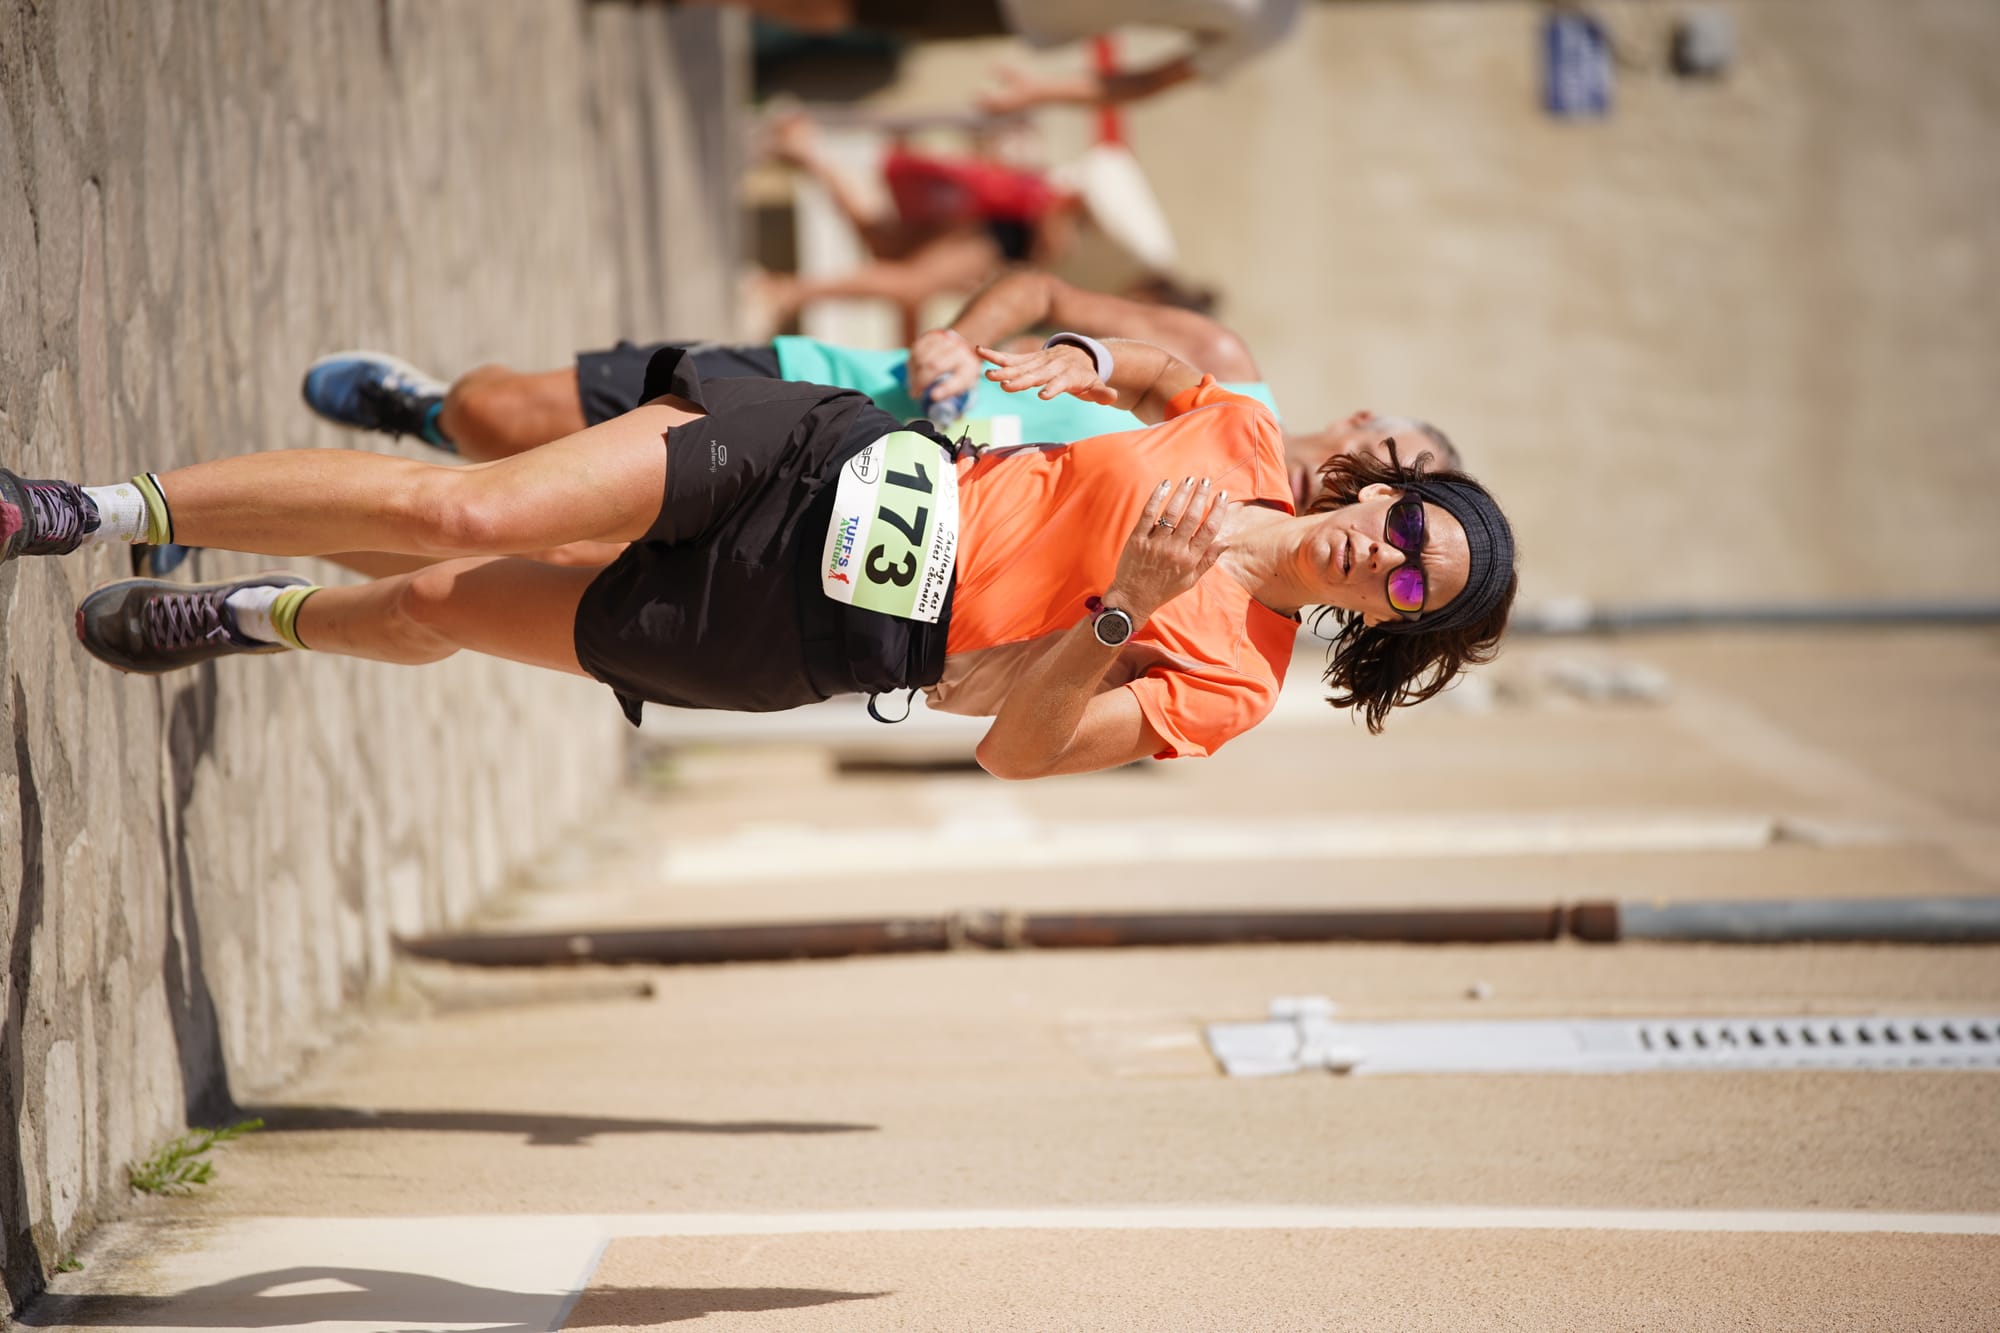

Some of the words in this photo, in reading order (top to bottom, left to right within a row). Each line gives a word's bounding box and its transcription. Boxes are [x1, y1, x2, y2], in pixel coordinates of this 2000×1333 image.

[709, 440, 717, 473] Kalenji
[830, 518, 850, 570] Aventure
[838, 516, 860, 567] TUFF'S
[865, 462, 933, 587] 173
[932, 522, 944, 560] vallées
[935, 530, 955, 585] Challenge
[918, 566, 937, 613] cévenoles
[930, 591, 942, 610] des
